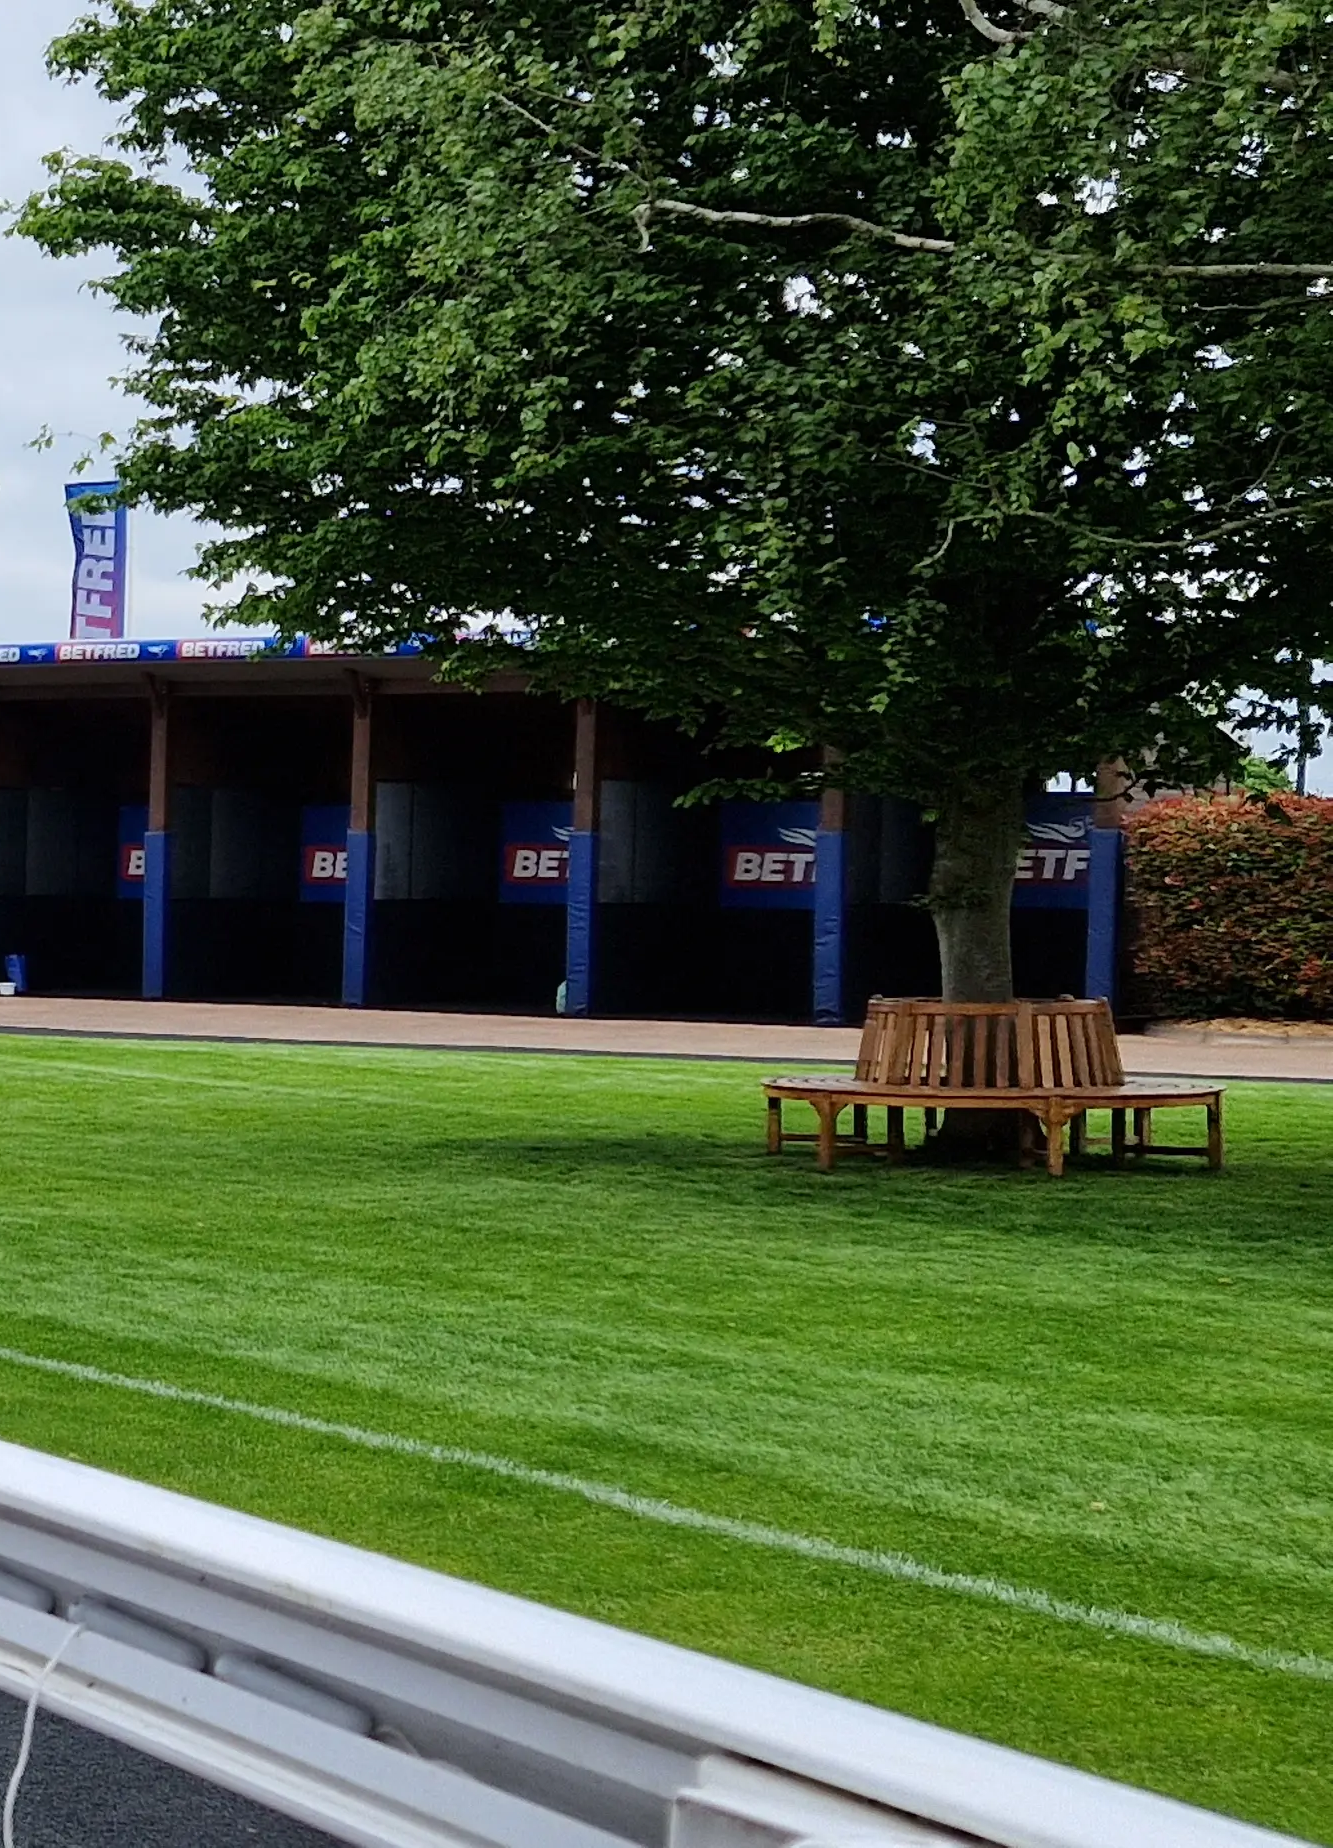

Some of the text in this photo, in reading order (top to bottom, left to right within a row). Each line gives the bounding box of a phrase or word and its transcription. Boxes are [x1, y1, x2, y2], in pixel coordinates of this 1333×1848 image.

[59, 644, 138, 660] BETFRED
[733, 851, 816, 882] BET
[1013, 849, 1091, 880] ETF
